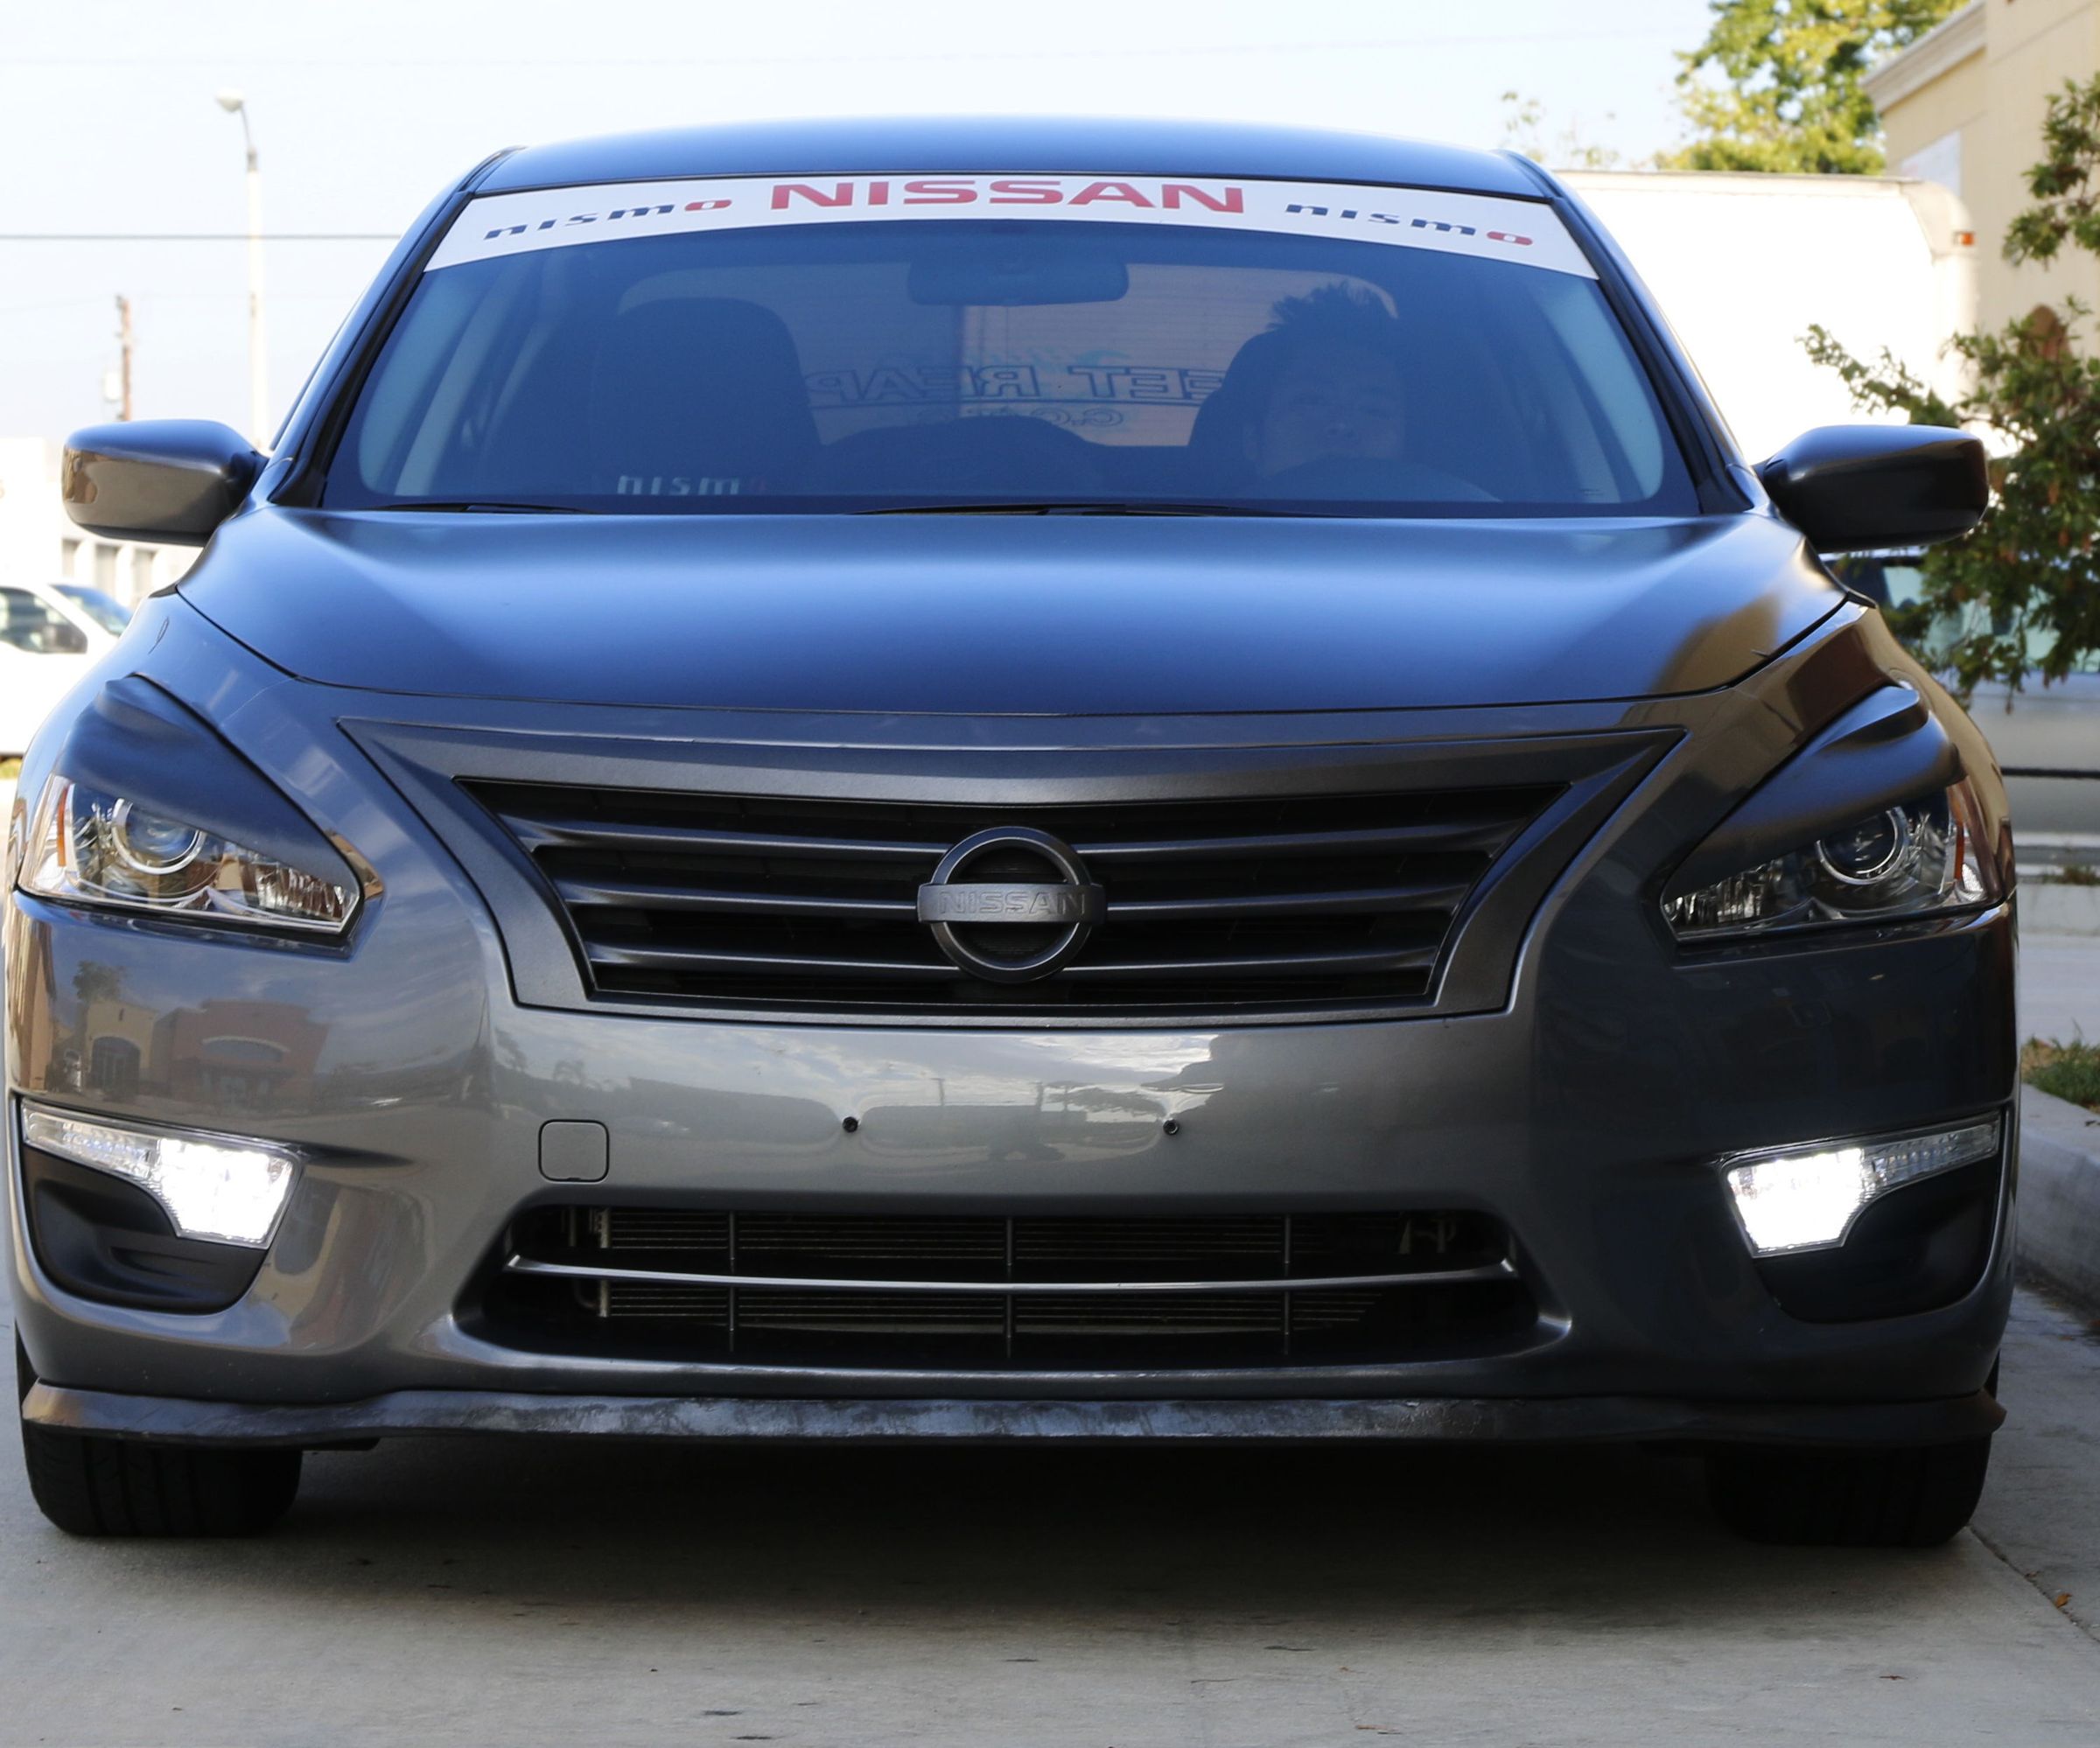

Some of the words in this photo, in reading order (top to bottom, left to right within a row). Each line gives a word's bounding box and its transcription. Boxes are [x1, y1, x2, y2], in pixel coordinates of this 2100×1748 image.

[483, 199, 732, 240] nismo
[771, 180, 1244, 213] NISSAN
[1285, 203, 1533, 246] nismo
[939, 891, 1085, 914] NISSAN
